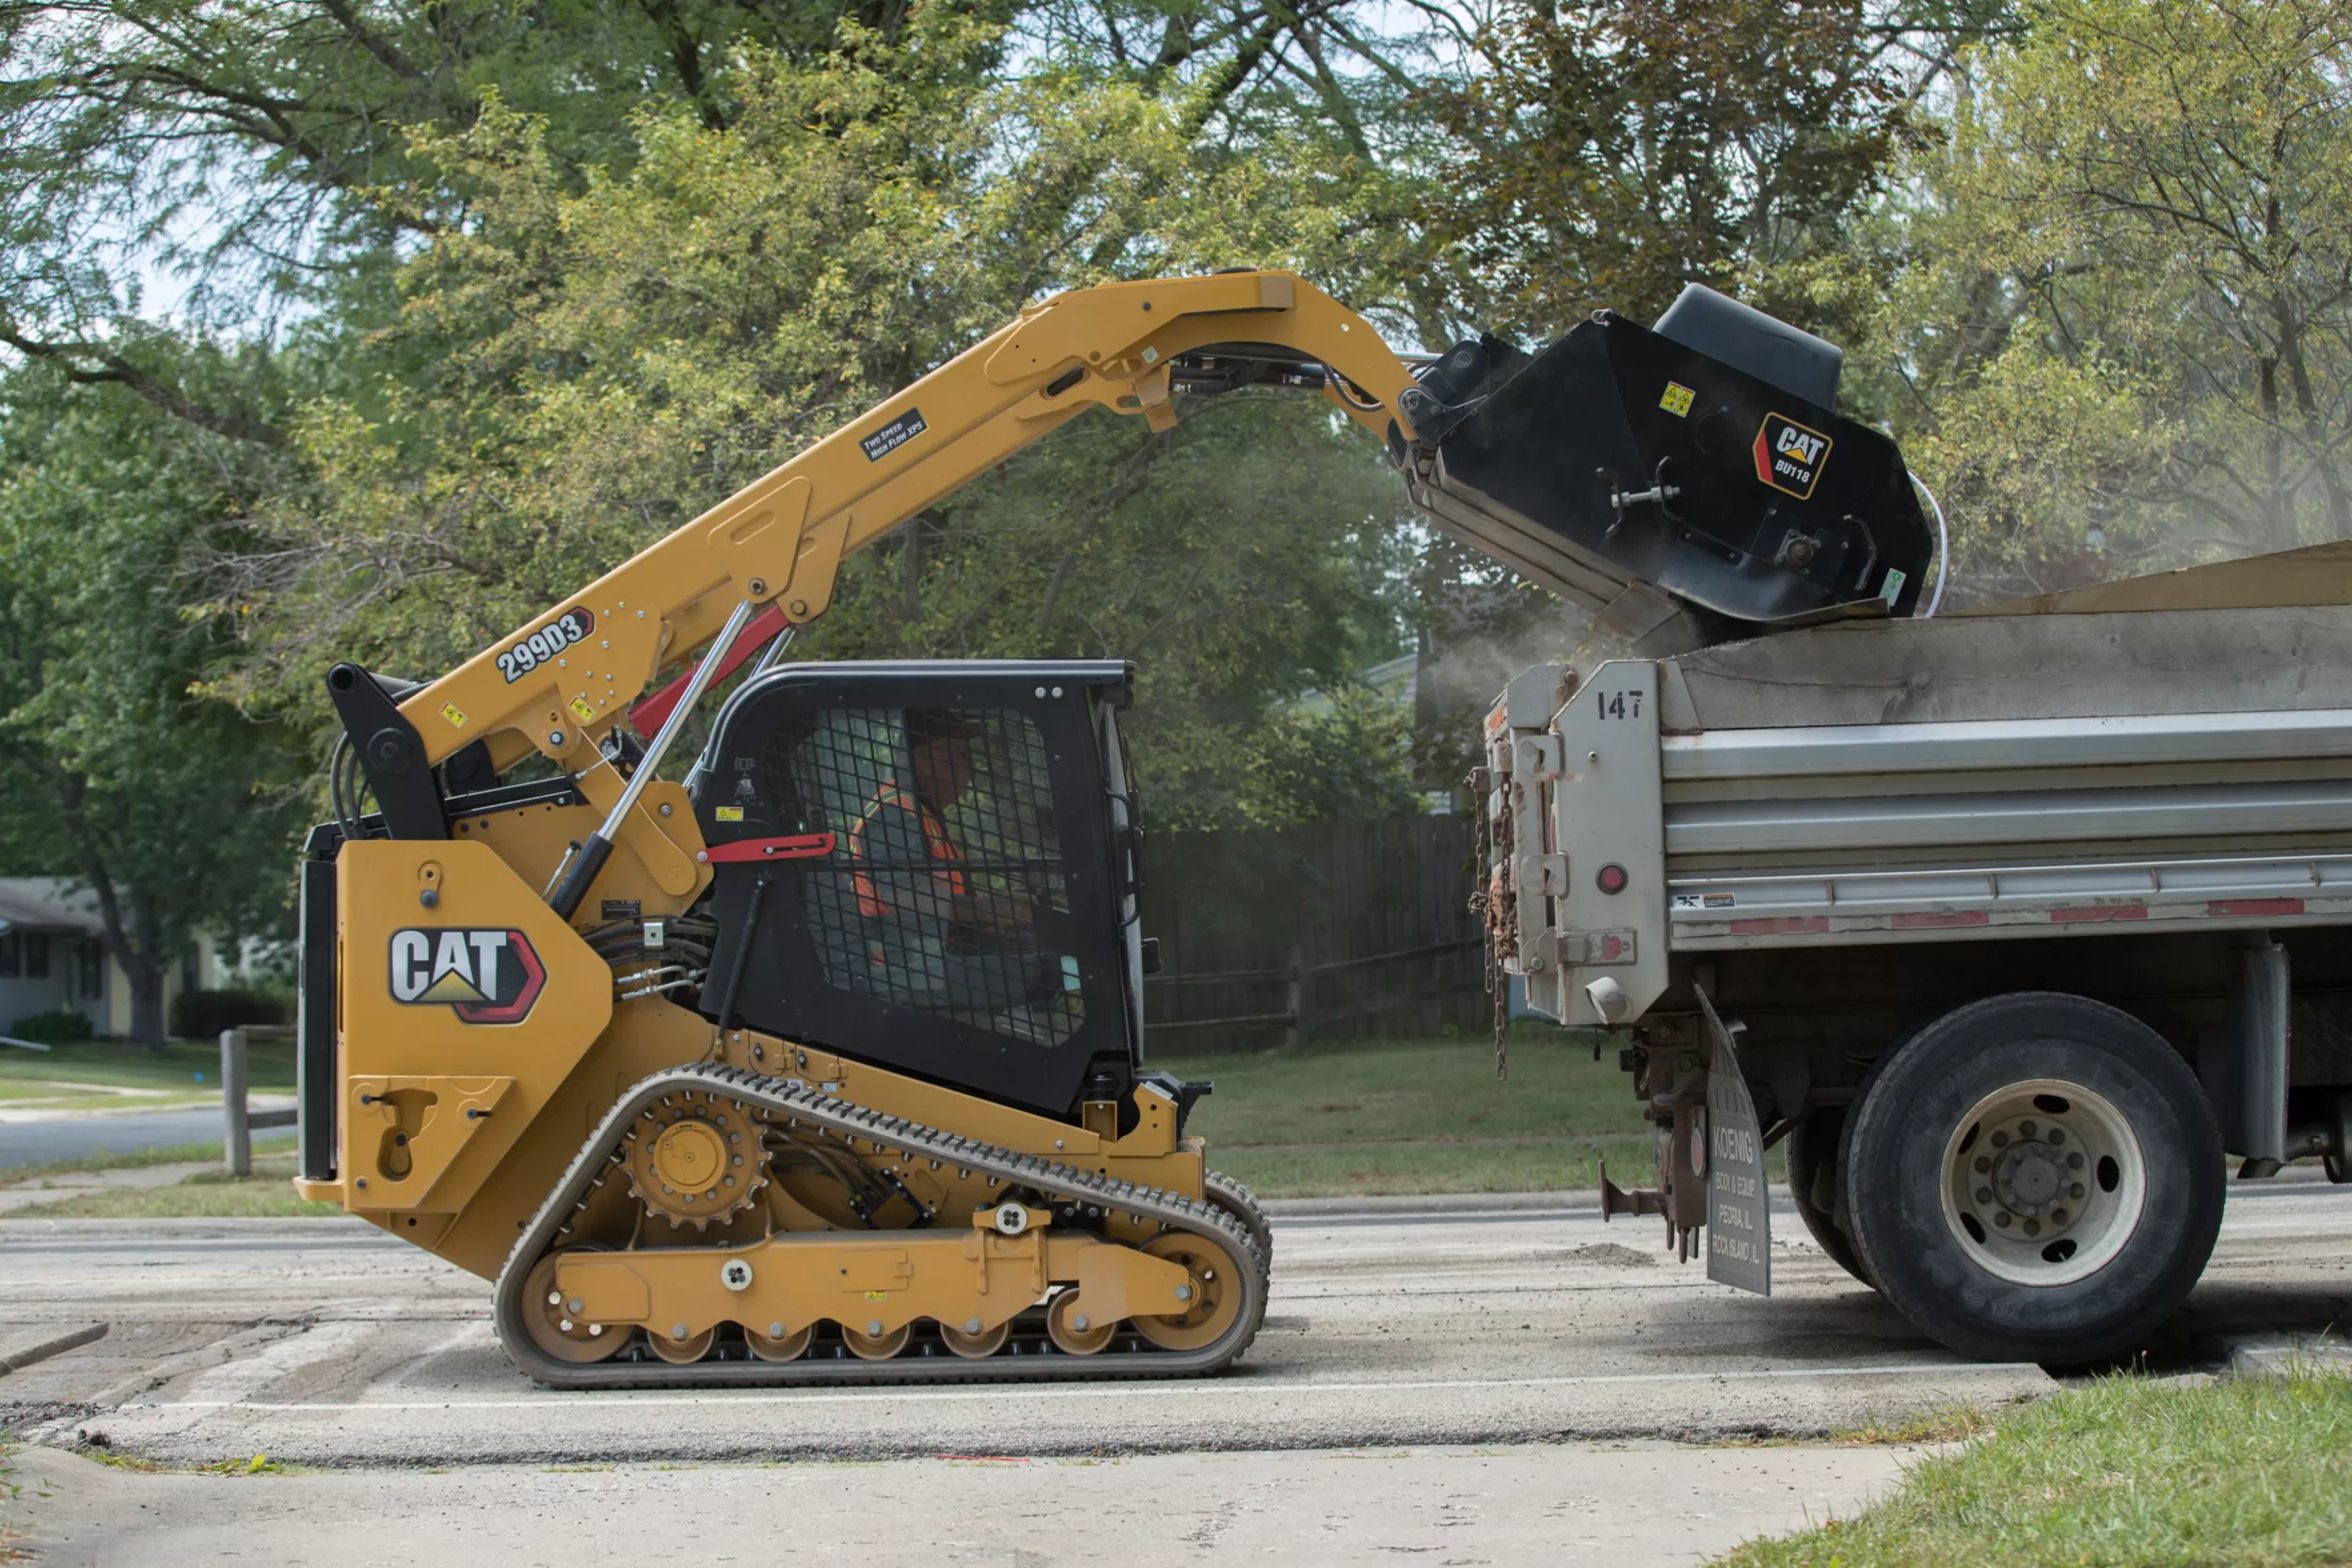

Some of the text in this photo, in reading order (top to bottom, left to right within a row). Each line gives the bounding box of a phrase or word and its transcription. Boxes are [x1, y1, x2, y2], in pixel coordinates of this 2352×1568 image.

[907, 420, 923, 436] XPS
[1776, 426, 1824, 466] CAT
[1774, 459, 1811, 483] BU118
[497, 614, 583, 682] 299D3
[1598, 690, 1644, 720] 147
[391, 930, 507, 1001] CAT
[1712, 1126, 1754, 1164] KOENIG
[1732, 1174, 1737, 1195] &
[1712, 1234, 1729, 1257] ROCK
